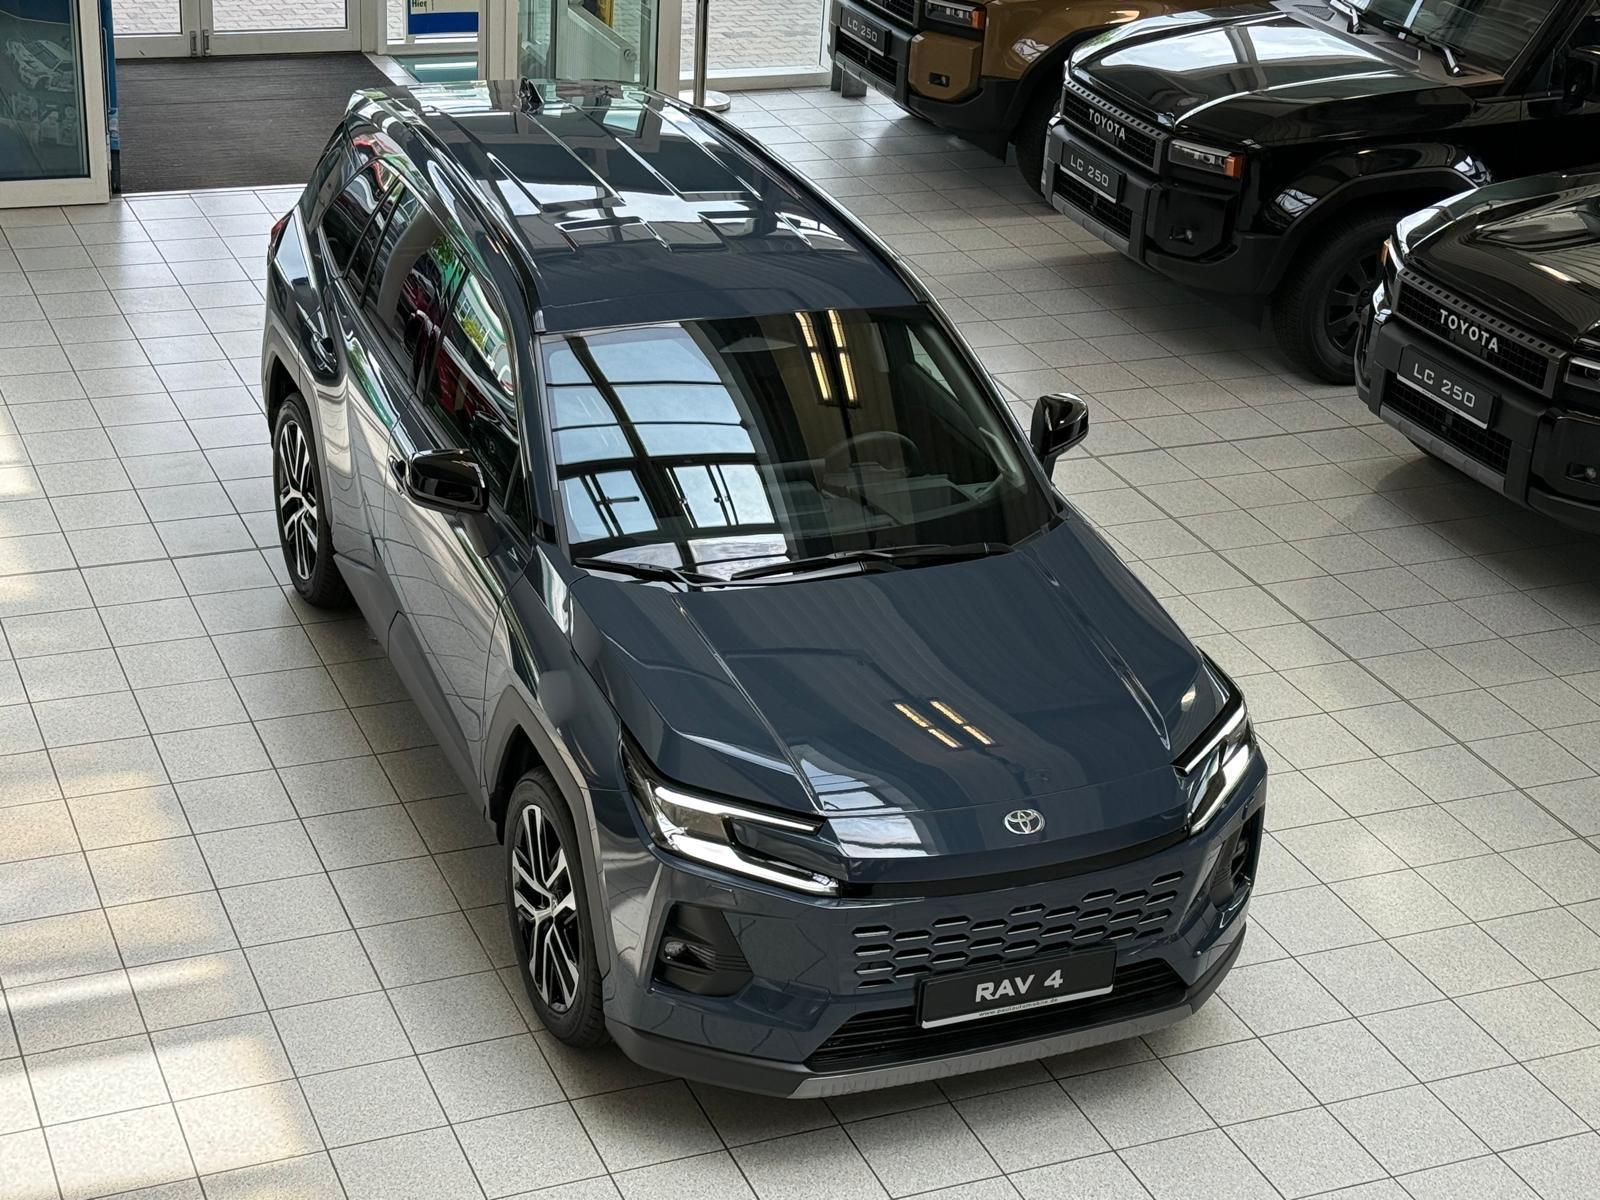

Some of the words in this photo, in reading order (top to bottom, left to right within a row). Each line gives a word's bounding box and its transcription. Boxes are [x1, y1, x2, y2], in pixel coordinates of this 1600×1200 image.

[847, 16, 858, 31] LC
[861, 25, 877, 42] 250
[1088, 108, 1126, 141] TOYOTA
[1070, 154, 1084, 171] LC
[1087, 165, 1109, 187] 250
[1439, 308, 1499, 353] TOYOTA
[1413, 363, 1435, 385] LC
[1440, 379, 1475, 408] 250
[975, 974, 1035, 1003] RAV
[1043, 969, 1063, 989] 4
